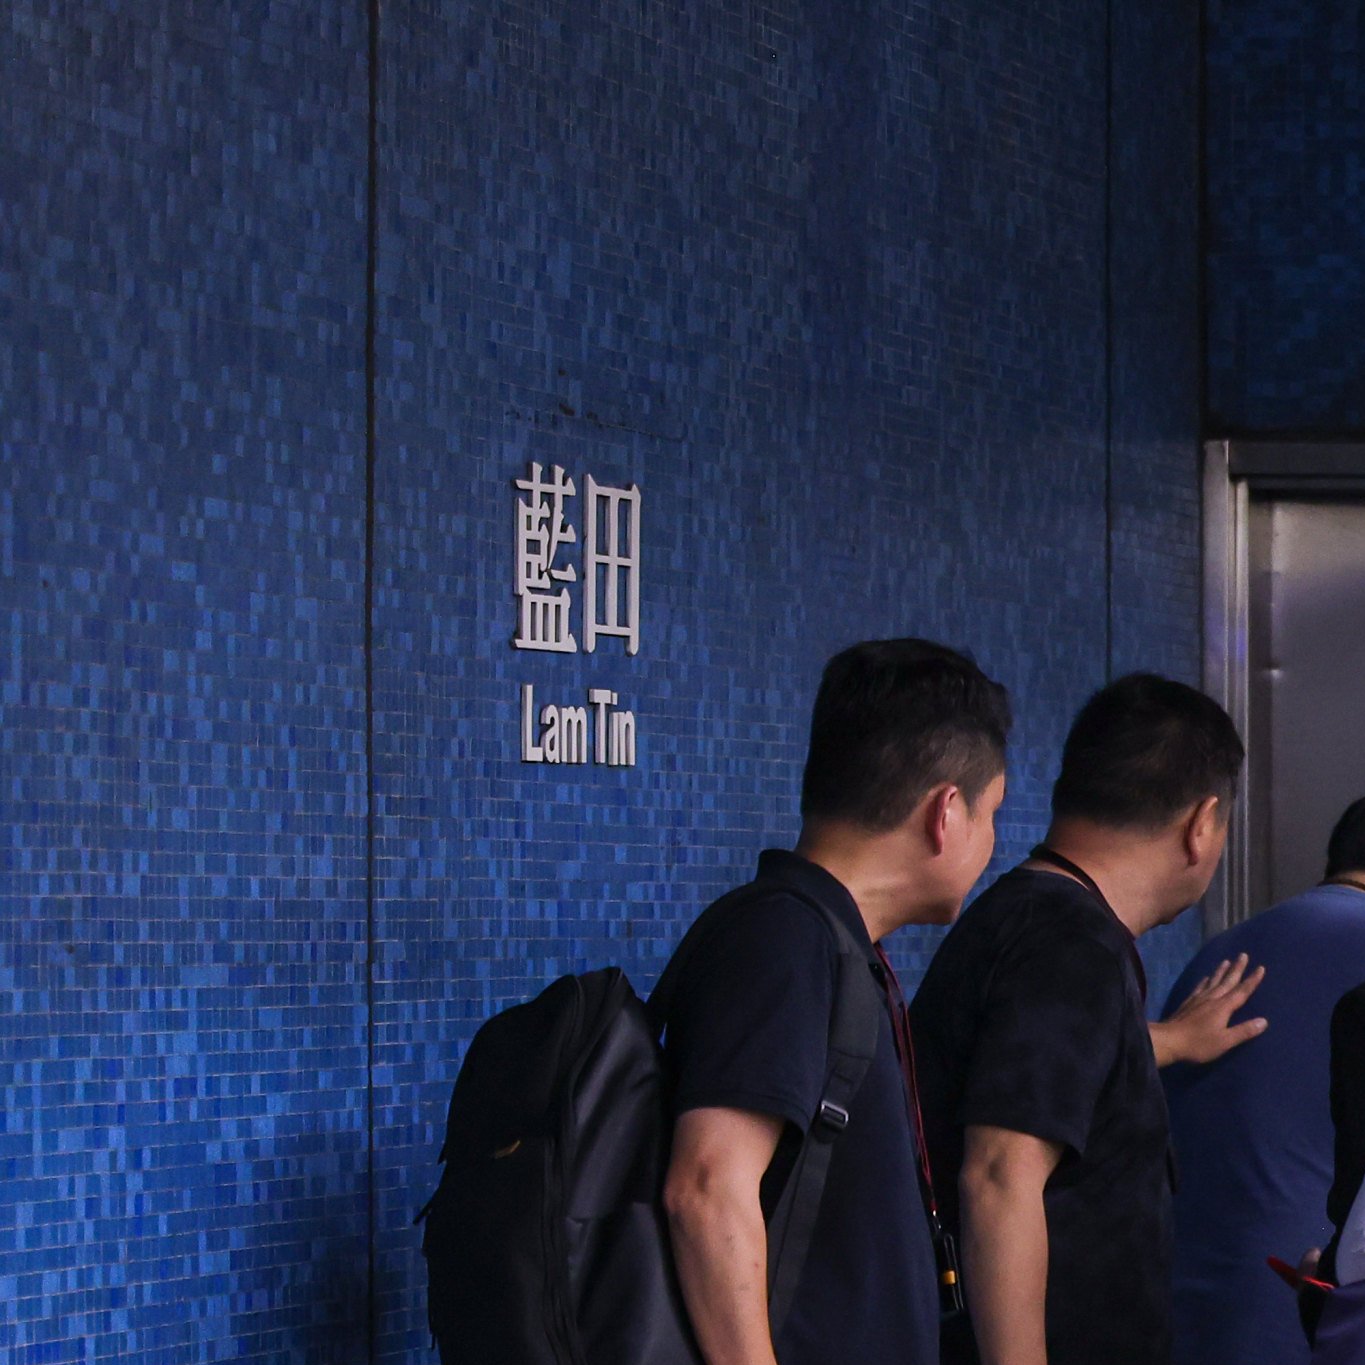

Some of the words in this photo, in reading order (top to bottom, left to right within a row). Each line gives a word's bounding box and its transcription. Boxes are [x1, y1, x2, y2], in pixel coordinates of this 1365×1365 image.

[514, 461, 641, 656] 藍田
[521, 683, 588, 764] Lam
[588, 688, 636, 766] Tin
